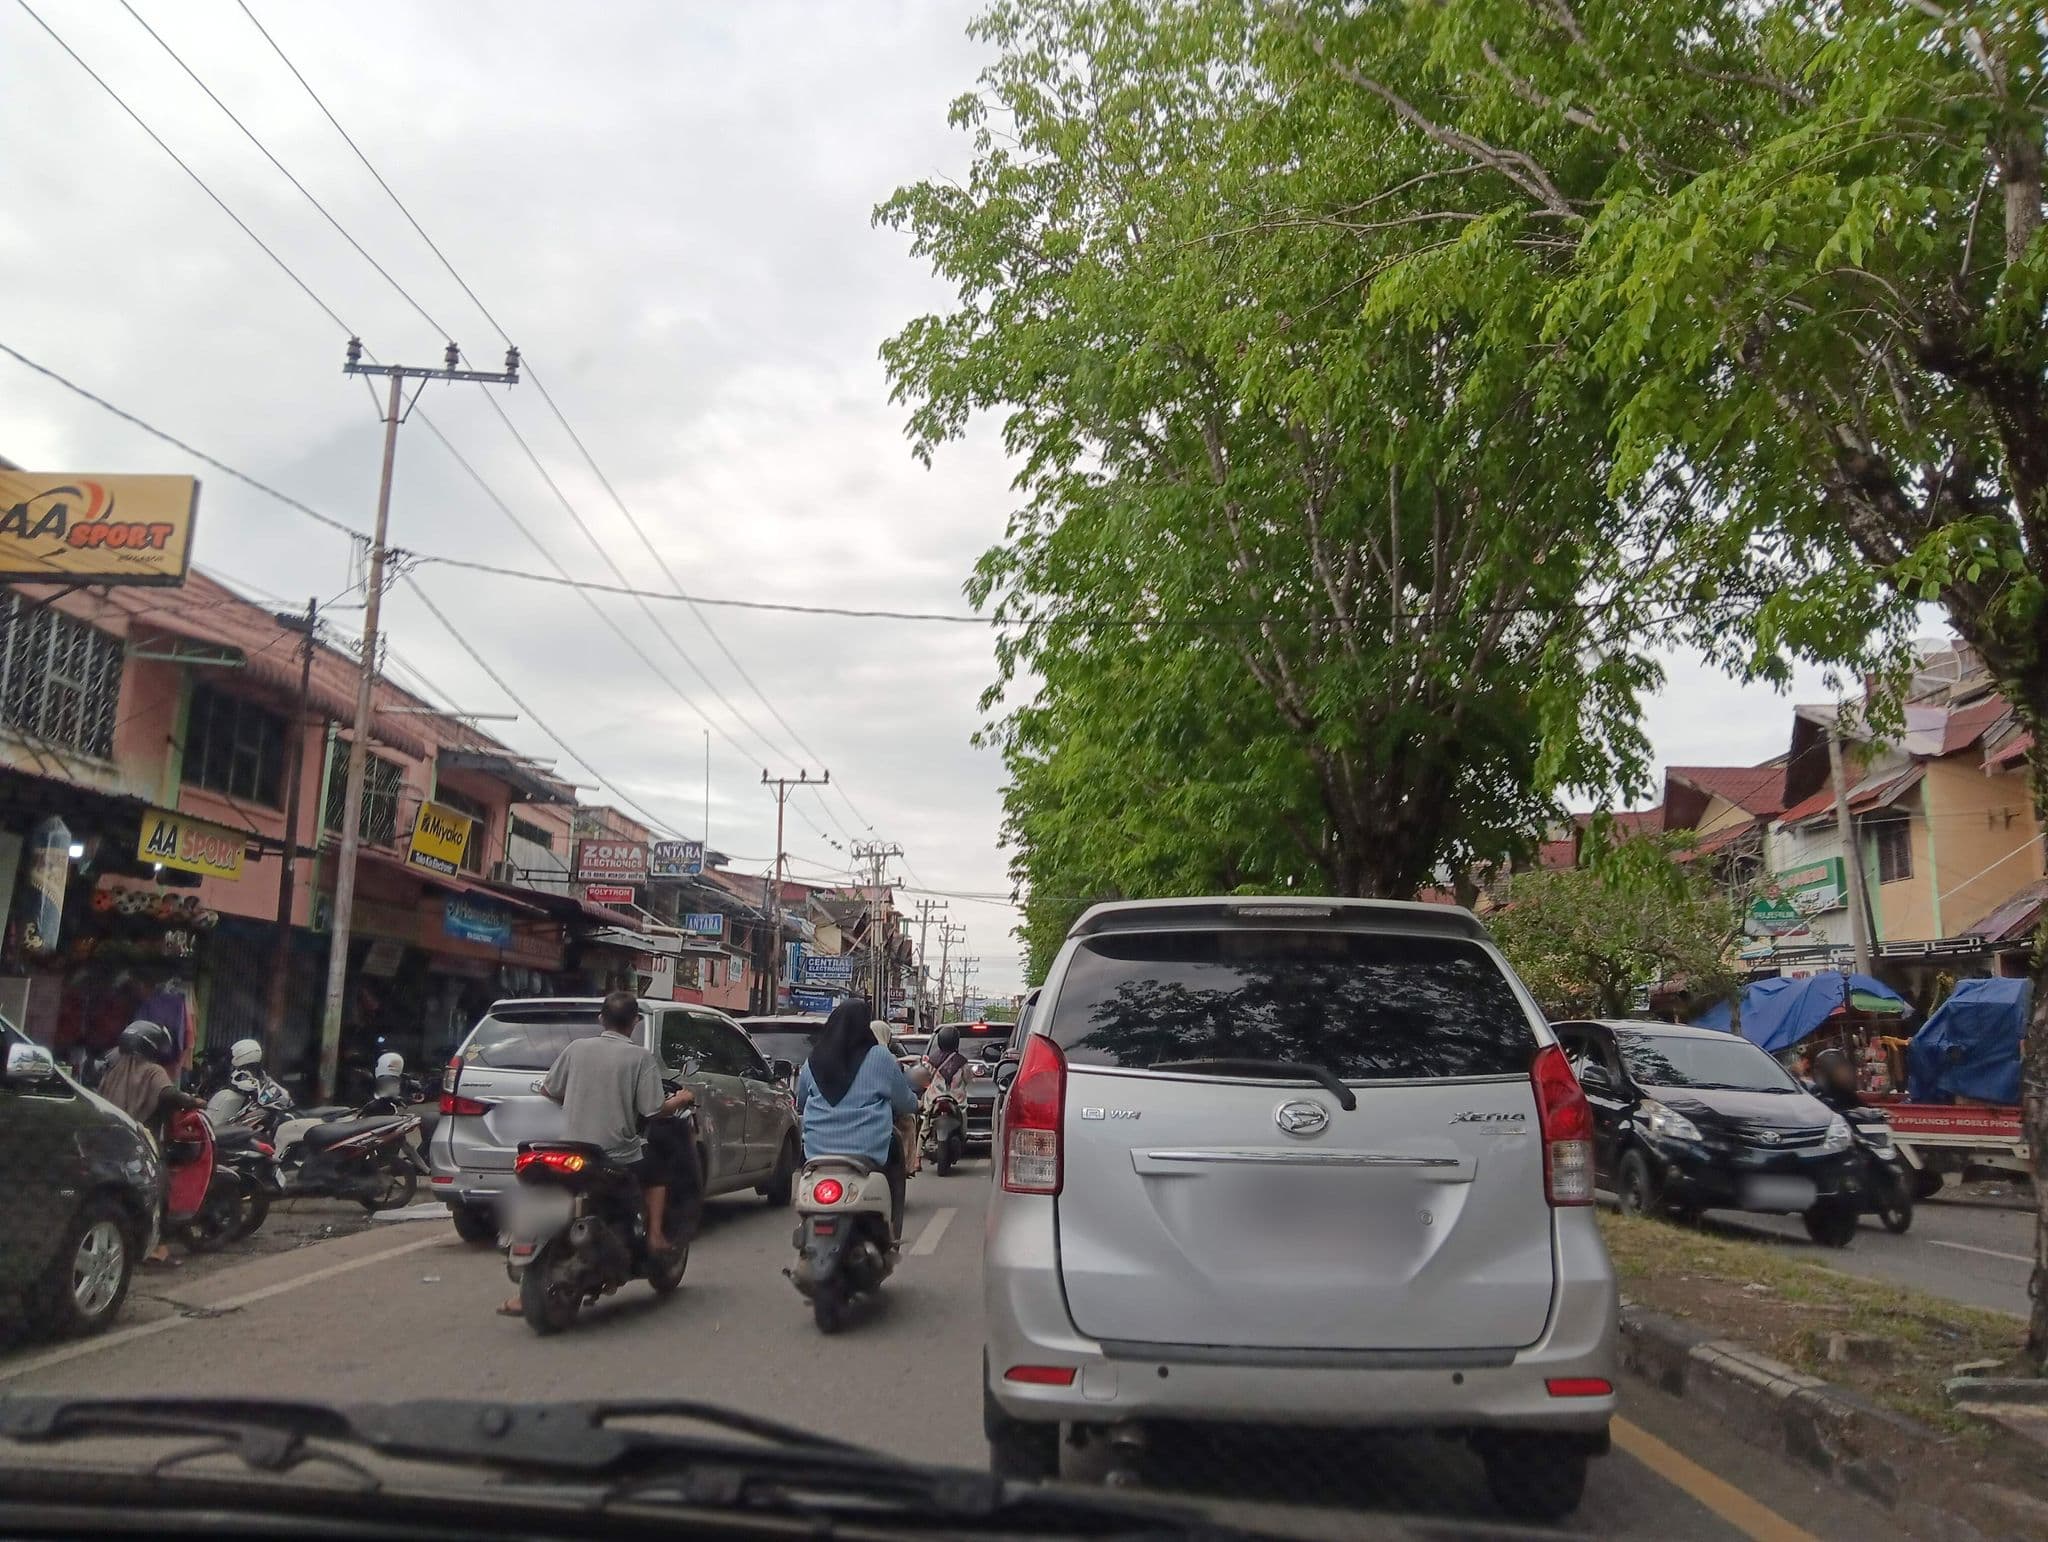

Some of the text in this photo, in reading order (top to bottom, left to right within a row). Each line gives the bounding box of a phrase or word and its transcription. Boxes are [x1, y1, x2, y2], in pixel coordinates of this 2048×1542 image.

[0, 503, 174, 550] AA SPORT
[429, 815, 463, 846] Miyako
[145, 820, 240, 871] AA SPORT
[656, 845, 701, 859] ANTARA
[583, 845, 642, 860] ZONA
[583, 857, 643, 868] ELECTRONICS
[589, 888, 631, 897] POLYTRON
[688, 918, 719, 930] ANTARA
[808, 958, 850, 967] CENTRAL
[1897, 1117, 1950, 1126] APPLIANCES
[1956, 1118, 1989, 1128] MOBILE
